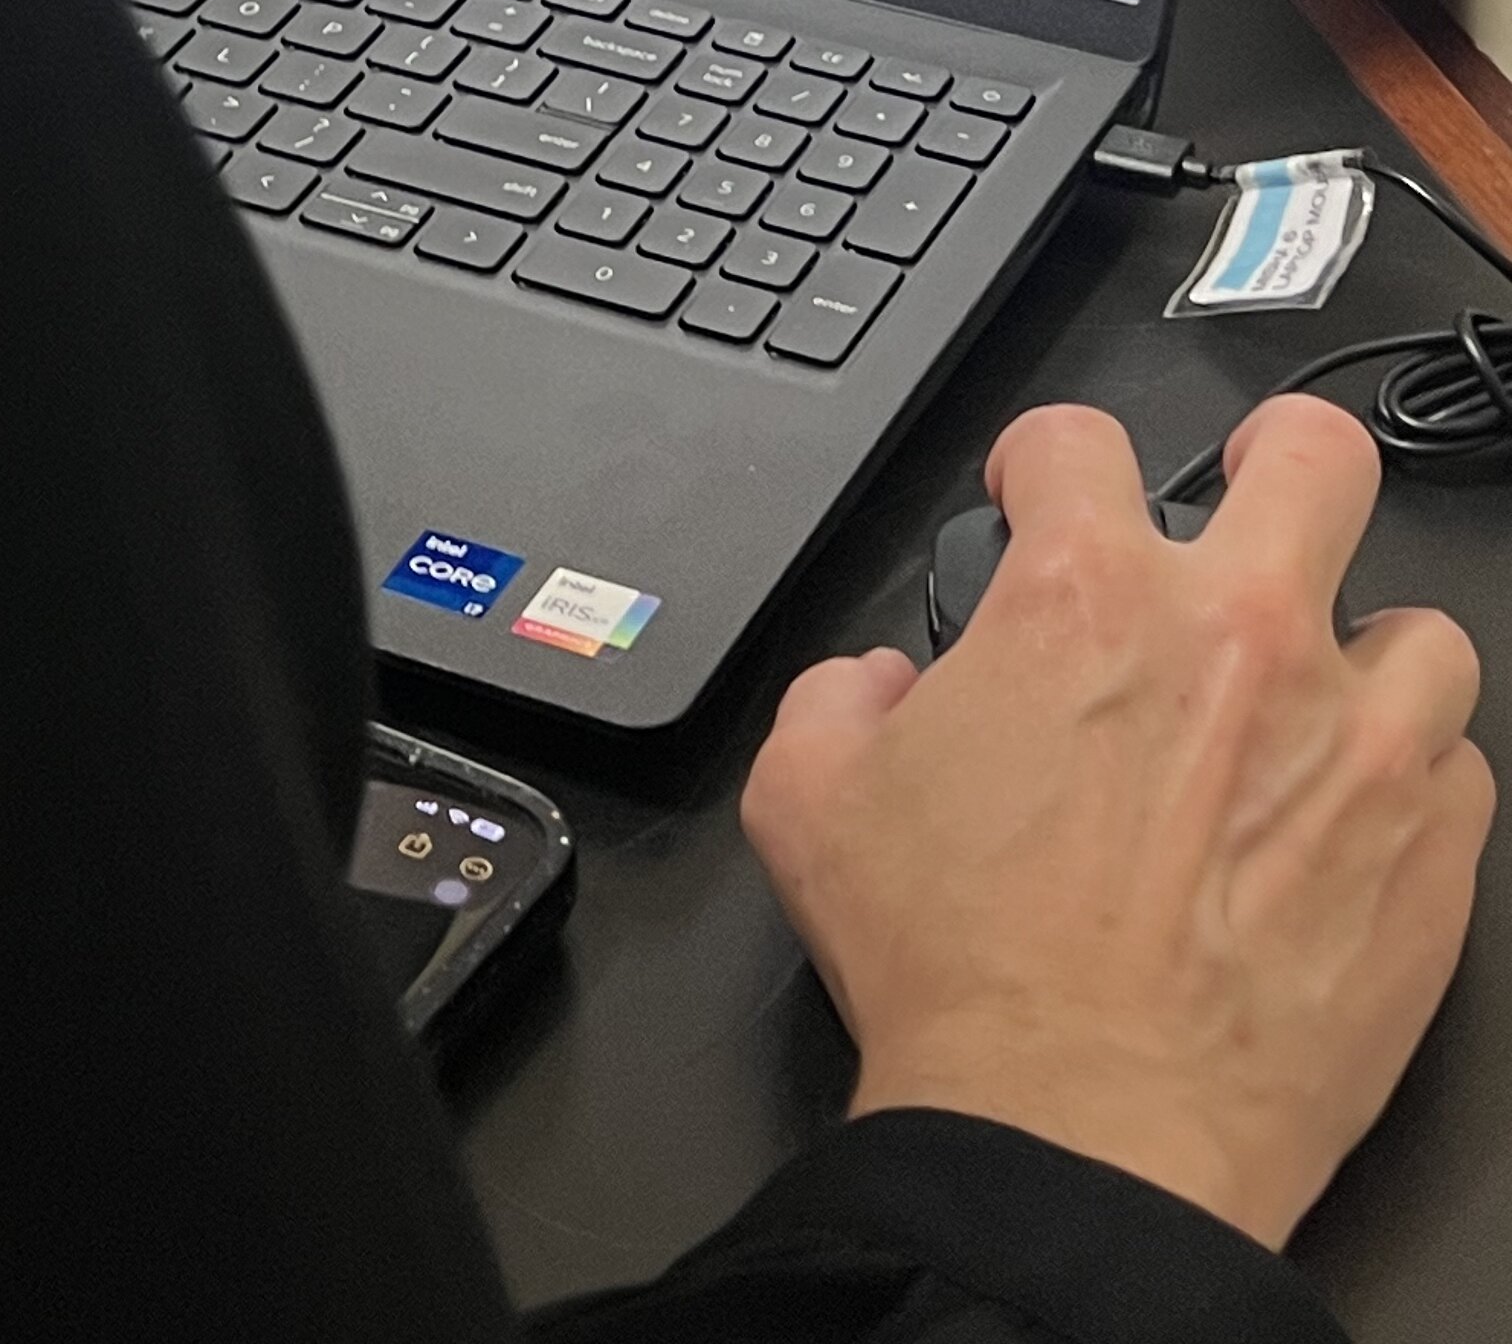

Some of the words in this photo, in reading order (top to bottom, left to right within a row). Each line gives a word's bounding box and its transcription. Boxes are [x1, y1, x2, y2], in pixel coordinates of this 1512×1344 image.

[583, 35, 657, 62] backspace
[677, 112, 693, 127] 7
[538, 133, 580, 149] enter
[754, 133, 773, 148] 8
[837, 154, 854, 169] 9
[502, 182, 538, 199] shift
[717, 180, 734, 195] 5
[799, 202, 816, 217] 6
[676, 227, 695, 243] 2
[760, 250, 779, 265] 3
[812, 297, 859, 314] enter
